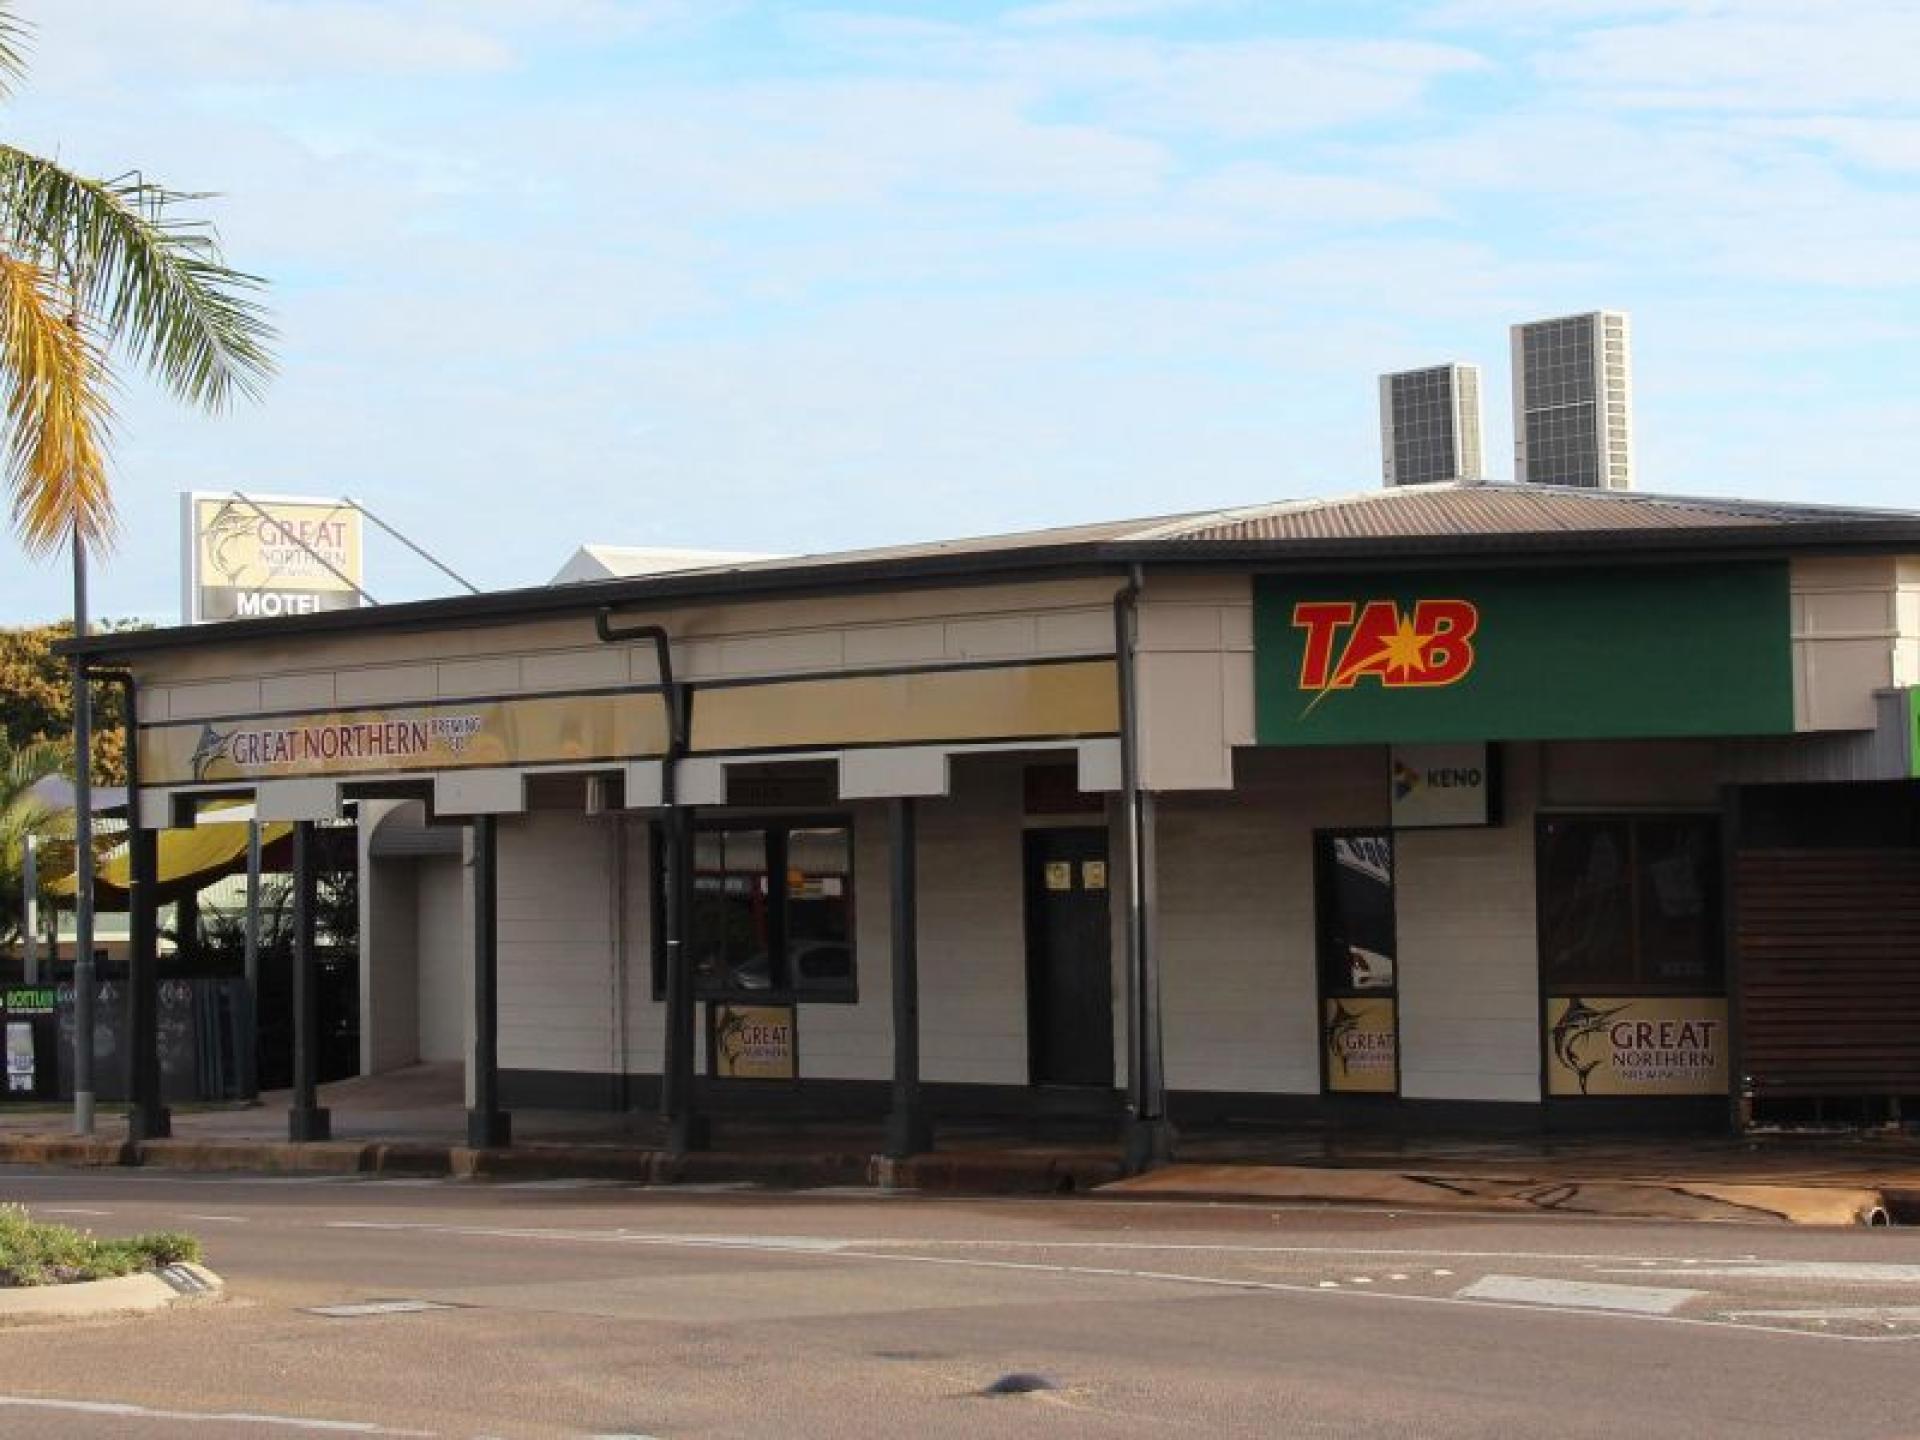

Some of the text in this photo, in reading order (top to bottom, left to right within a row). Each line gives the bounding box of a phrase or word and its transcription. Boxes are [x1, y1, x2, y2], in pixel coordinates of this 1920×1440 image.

[257, 520, 346, 548] GREAT
[1294, 600, 1478, 689] TAB
[232, 720, 428, 764] GREAT NORTHERN
[1427, 767, 1482, 789] KENO
[741, 1025, 788, 1046] GREAT
[1346, 1032, 1393, 1051] GREAT
[1610, 1021, 1717, 1050] GREAT
[1612, 1050, 1715, 1067] NORTHERN
